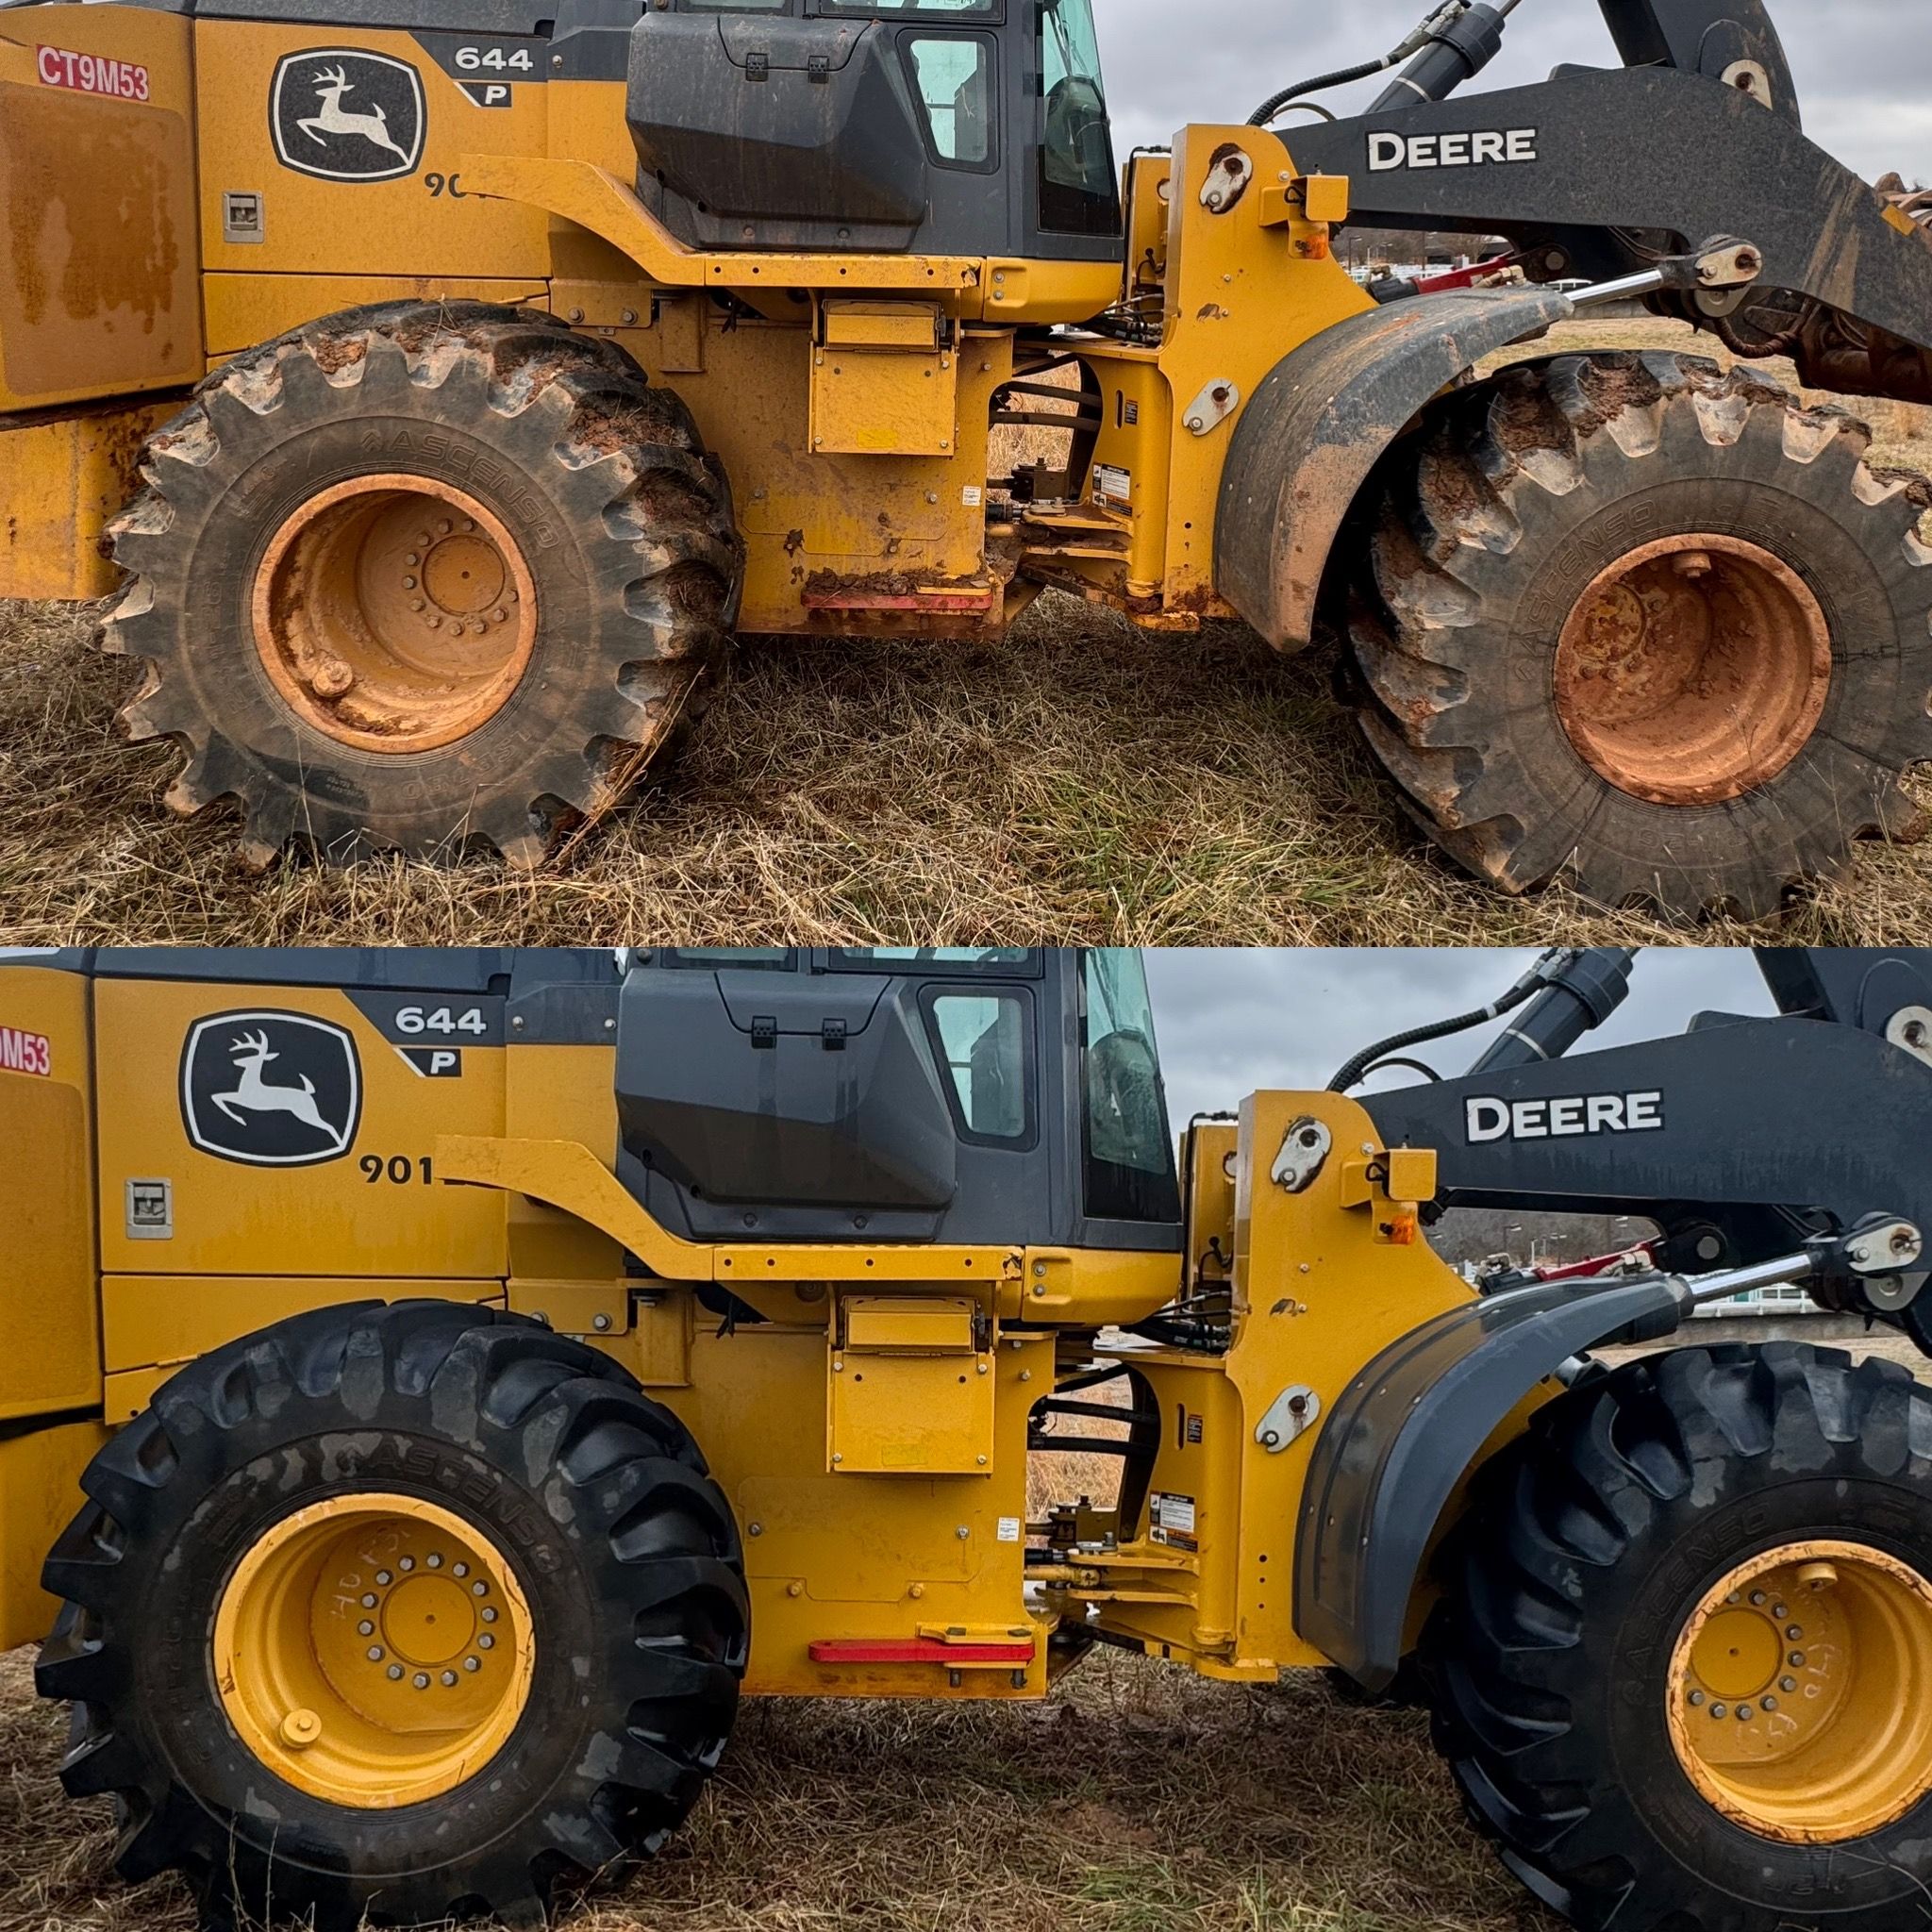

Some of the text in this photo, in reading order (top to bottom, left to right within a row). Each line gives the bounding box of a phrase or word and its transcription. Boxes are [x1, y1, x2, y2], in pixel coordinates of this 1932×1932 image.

[39, 46, 149, 101] CT9M53
[455, 46, 534, 72] 644
[484, 85, 508, 105] P
[1368, 128, 1537, 172] DEERE
[425, 172, 487, 199] 90
[390, 429, 560, 549] ASCENSO
[1519, 499, 1657, 658] ASCENSO
[395, 1006, 488, 1036] 644
[0, 1028, 51, 1075] M53
[429, 1051, 457, 1075] P
[1466, 1091, 1662, 1142] DEERE
[359, 1154, 466, 1186] 901
[371, 1440, 562, 1574] ASCENSO
